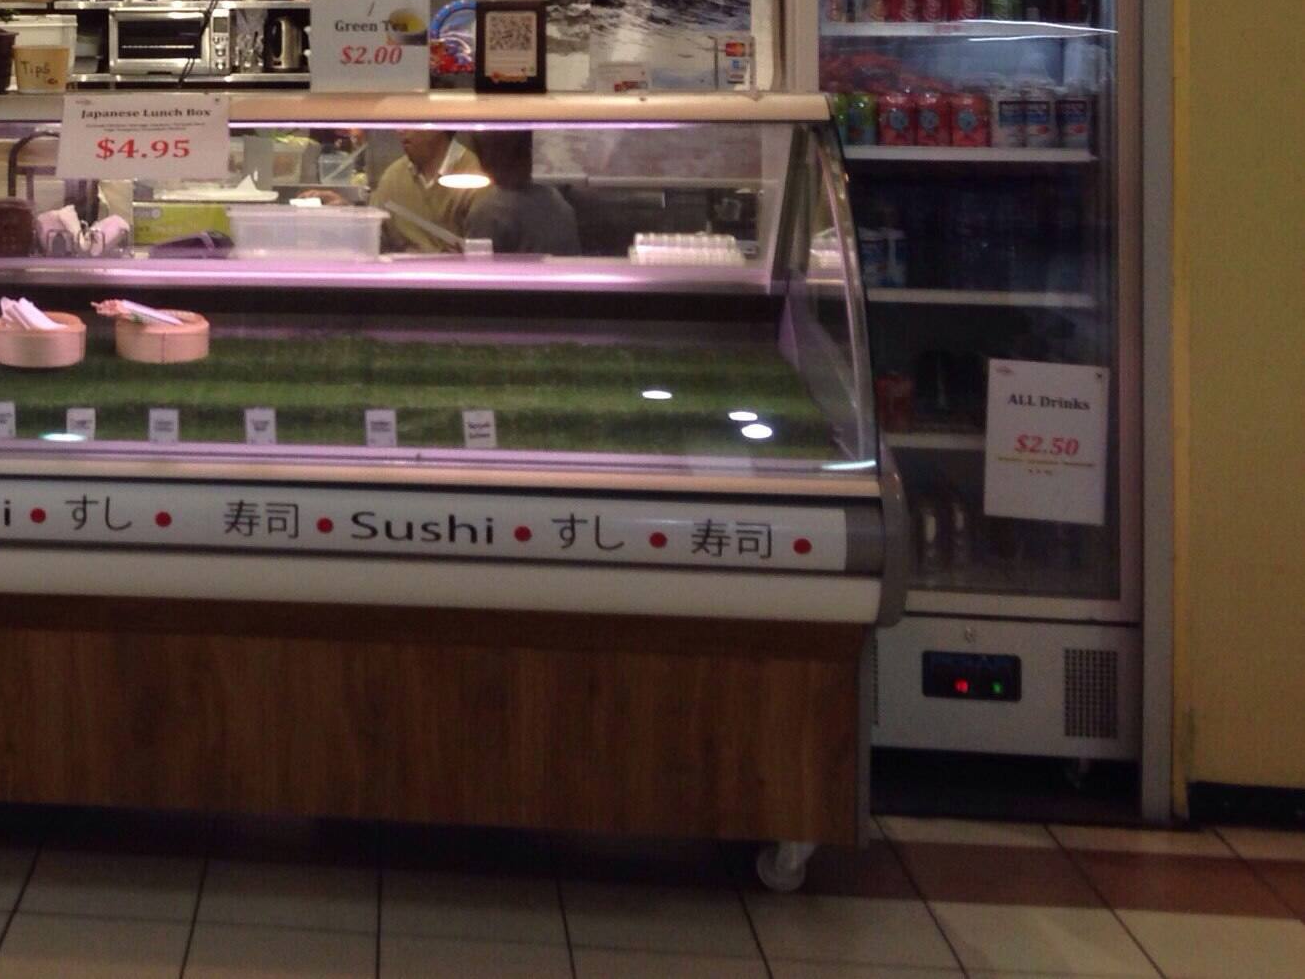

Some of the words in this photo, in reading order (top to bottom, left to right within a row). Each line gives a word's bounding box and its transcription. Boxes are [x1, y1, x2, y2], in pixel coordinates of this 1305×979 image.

[334, 20, 378, 33] Green
[382, 20, 409, 33] Tea
[341, 45, 403, 65] $2.00
[81, 109, 140, 120] Japanese
[143, 108, 182, 118] Lunch
[187, 108, 211, 117] Box
[96, 137, 190, 160] $4.95
[1007, 393, 1037, 407] ALL
[1040, 395, 1091, 411] Drinks
[1014, 433, 1080, 457] $2.50
[65, 494, 133, 531] すし
[223, 499, 301, 538] 寿司
[350, 511, 494, 545] Sushi
[552, 512, 626, 550] すし
[691, 519, 773, 560] 寿司
